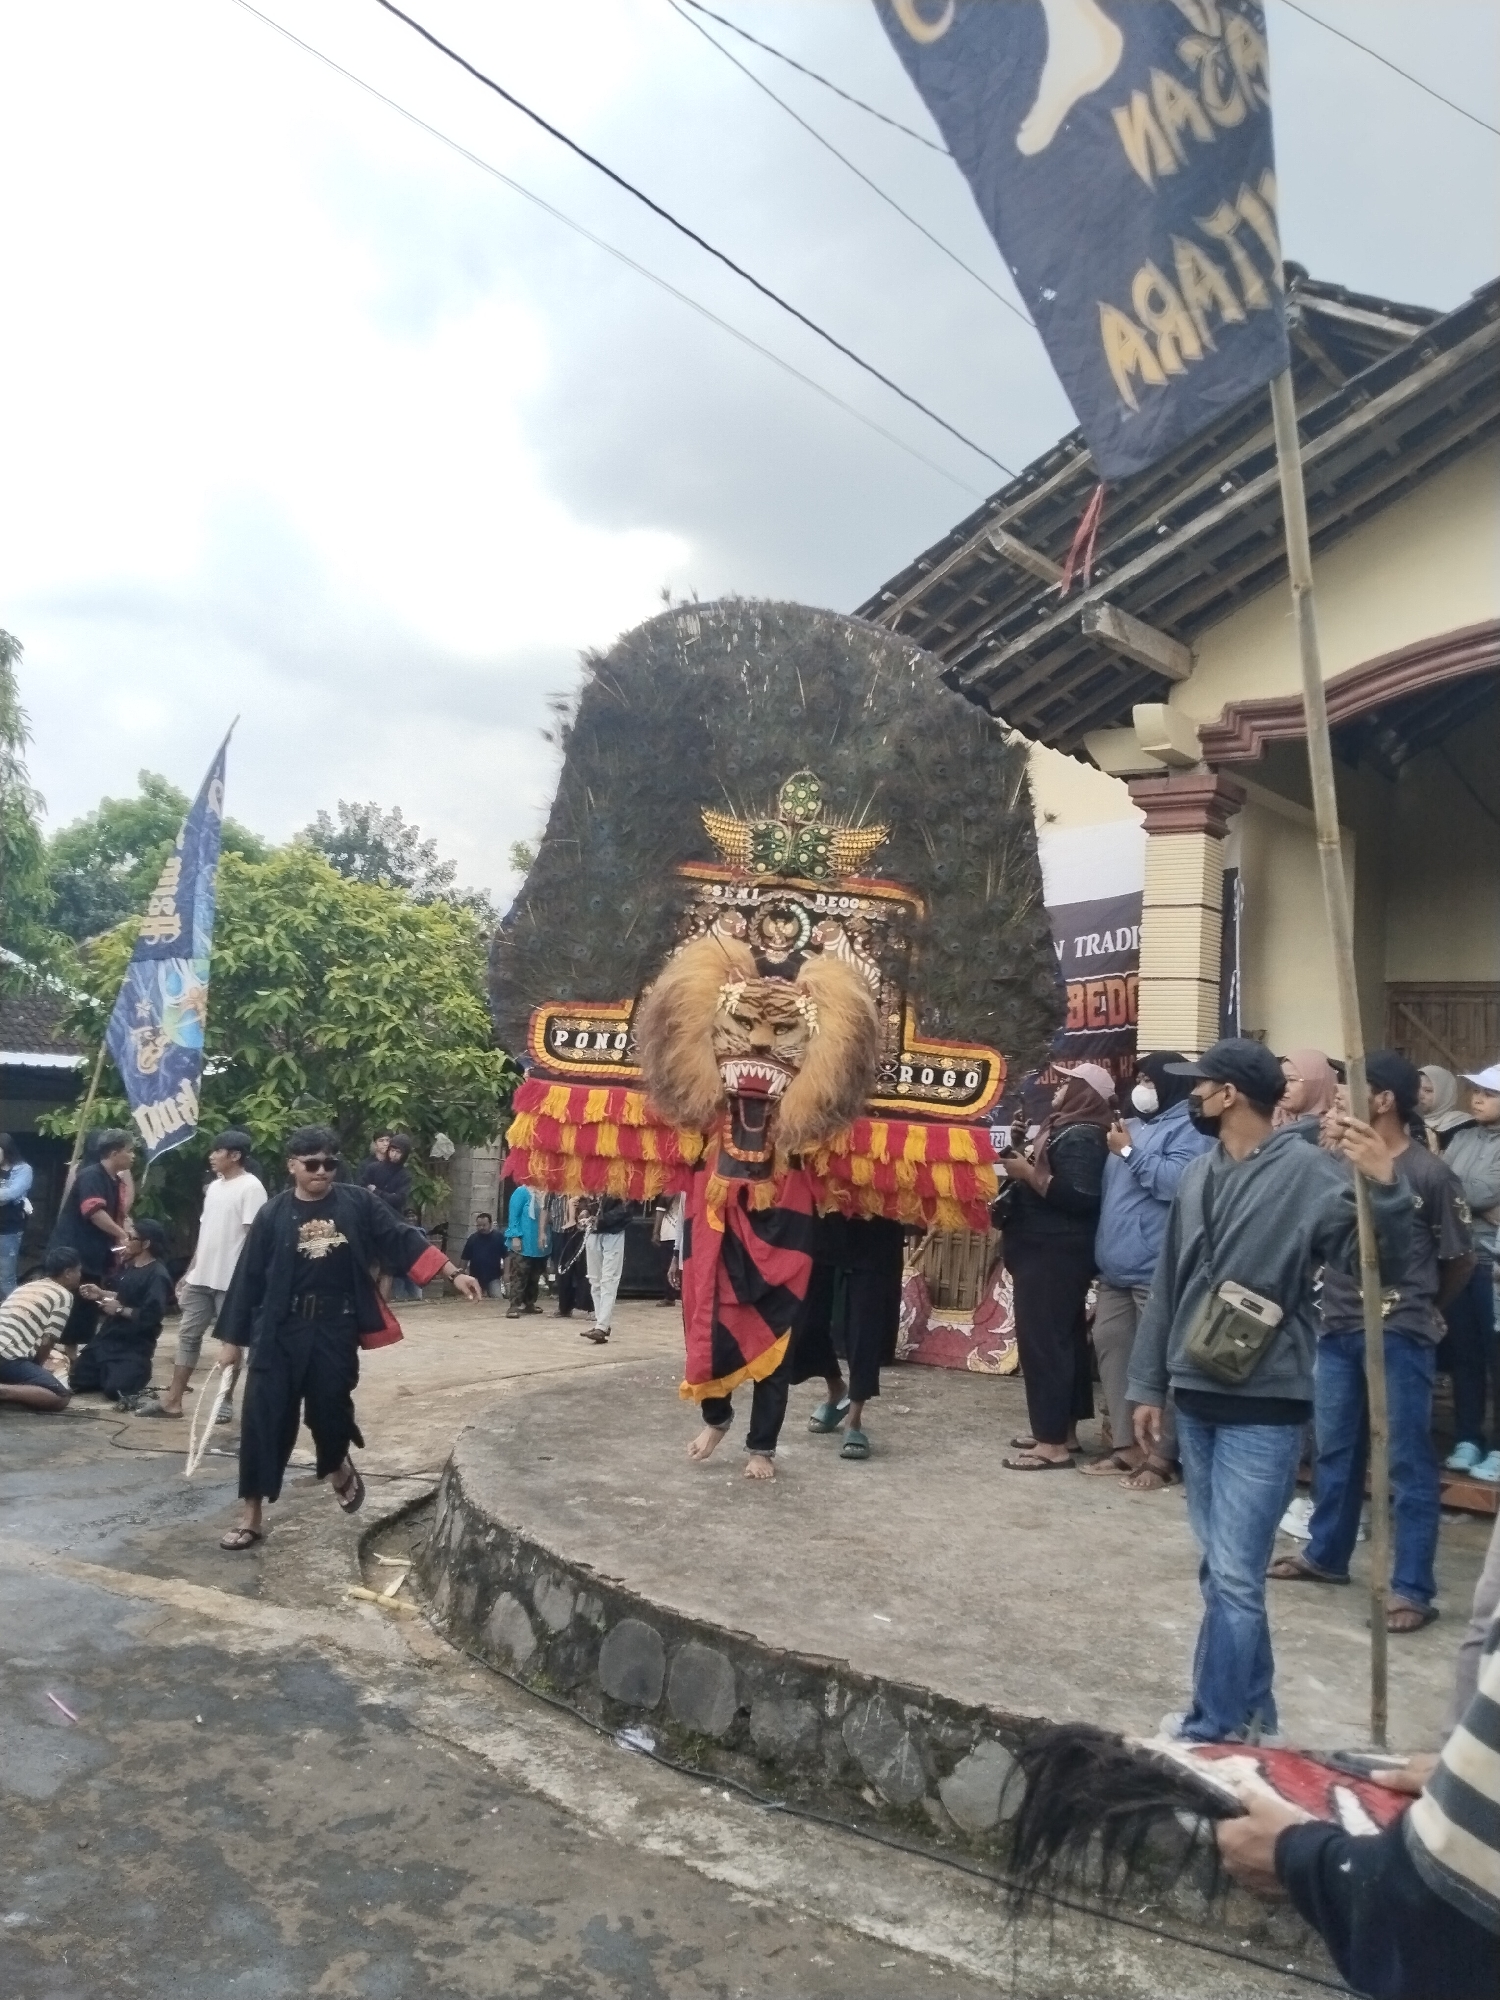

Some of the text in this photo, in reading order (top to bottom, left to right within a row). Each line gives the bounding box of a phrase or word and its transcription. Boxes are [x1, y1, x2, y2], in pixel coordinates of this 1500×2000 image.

[712, 885, 860, 909] SENI REOG
[1074, 926, 1141, 958] TRADI
[554, 1030, 979, 1088] PONO ROGO
